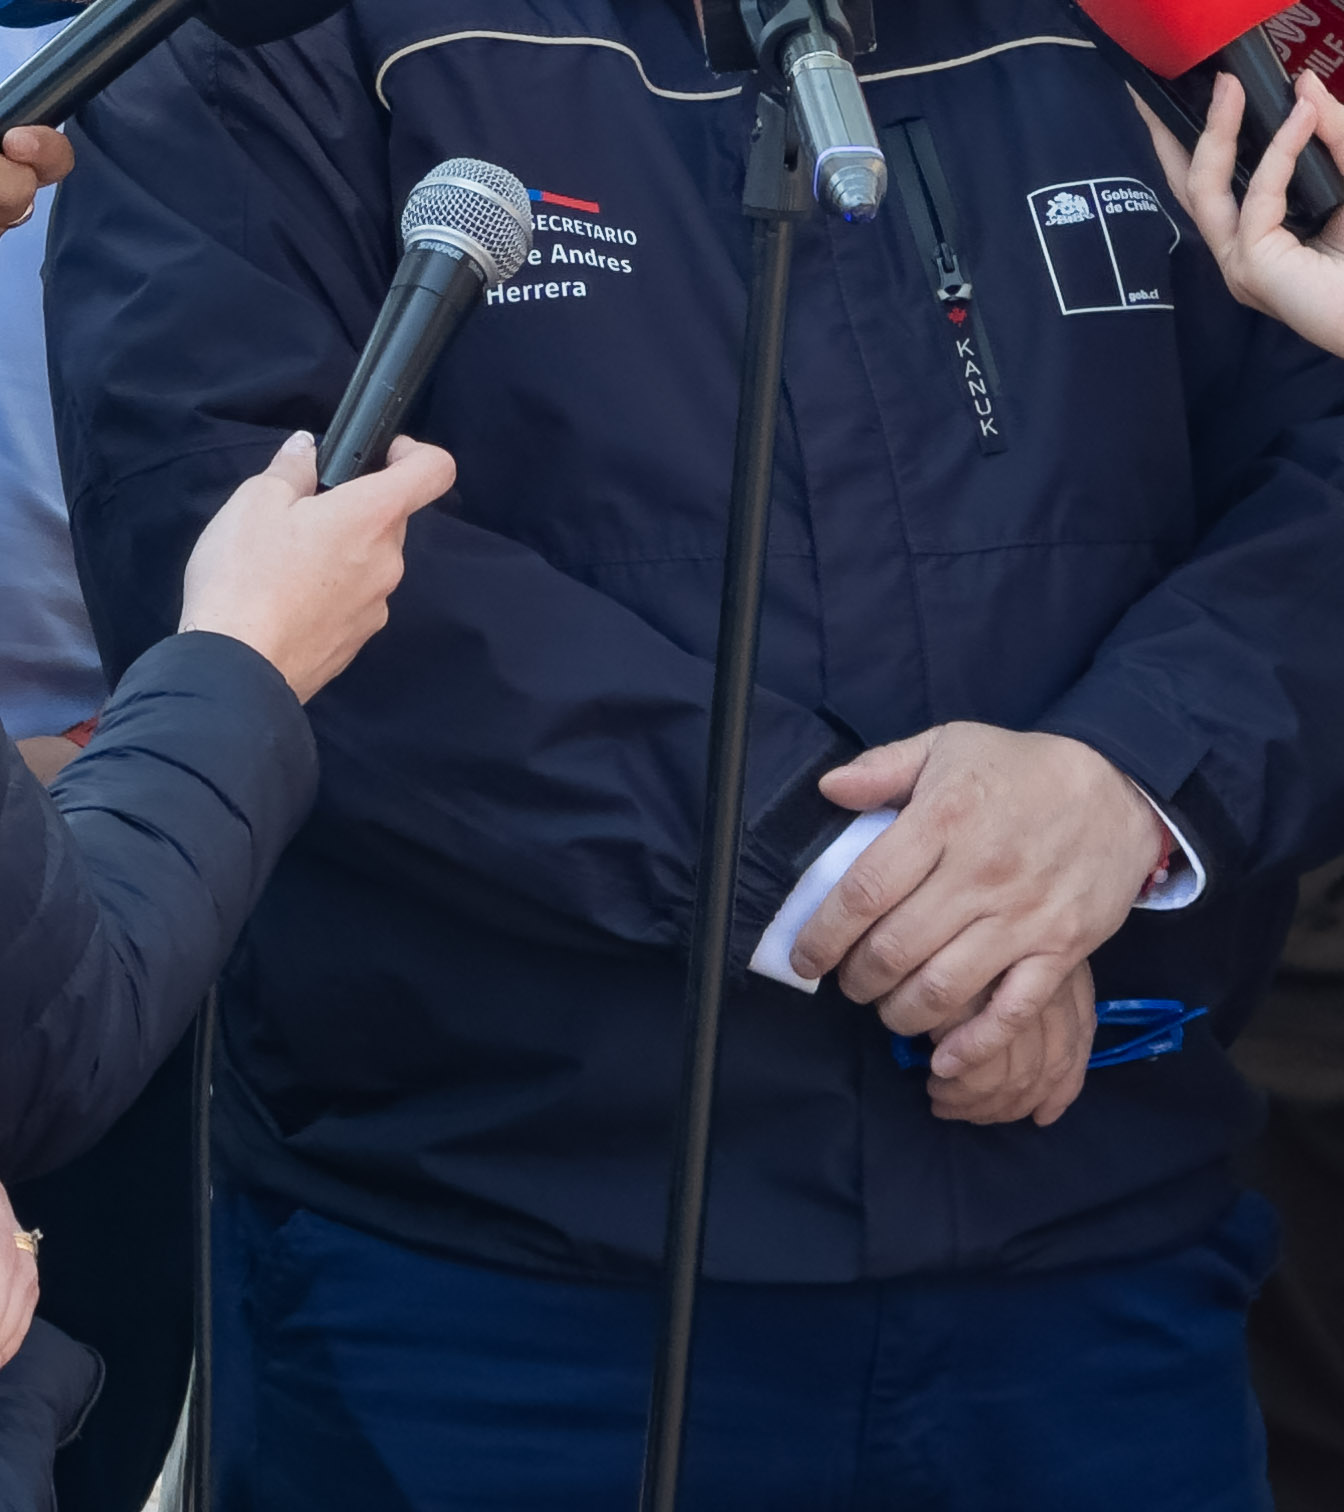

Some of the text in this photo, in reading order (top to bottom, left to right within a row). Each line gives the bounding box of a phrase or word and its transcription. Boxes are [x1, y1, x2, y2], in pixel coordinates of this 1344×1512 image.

[1105, 199, 1158, 214] de Chile
[551, 243, 633, 273] Andres
[486, 280, 587, 305] Herrera
[1128, 289, 1159, 303] gob.cl
[956, 338, 998, 437] KANUK
